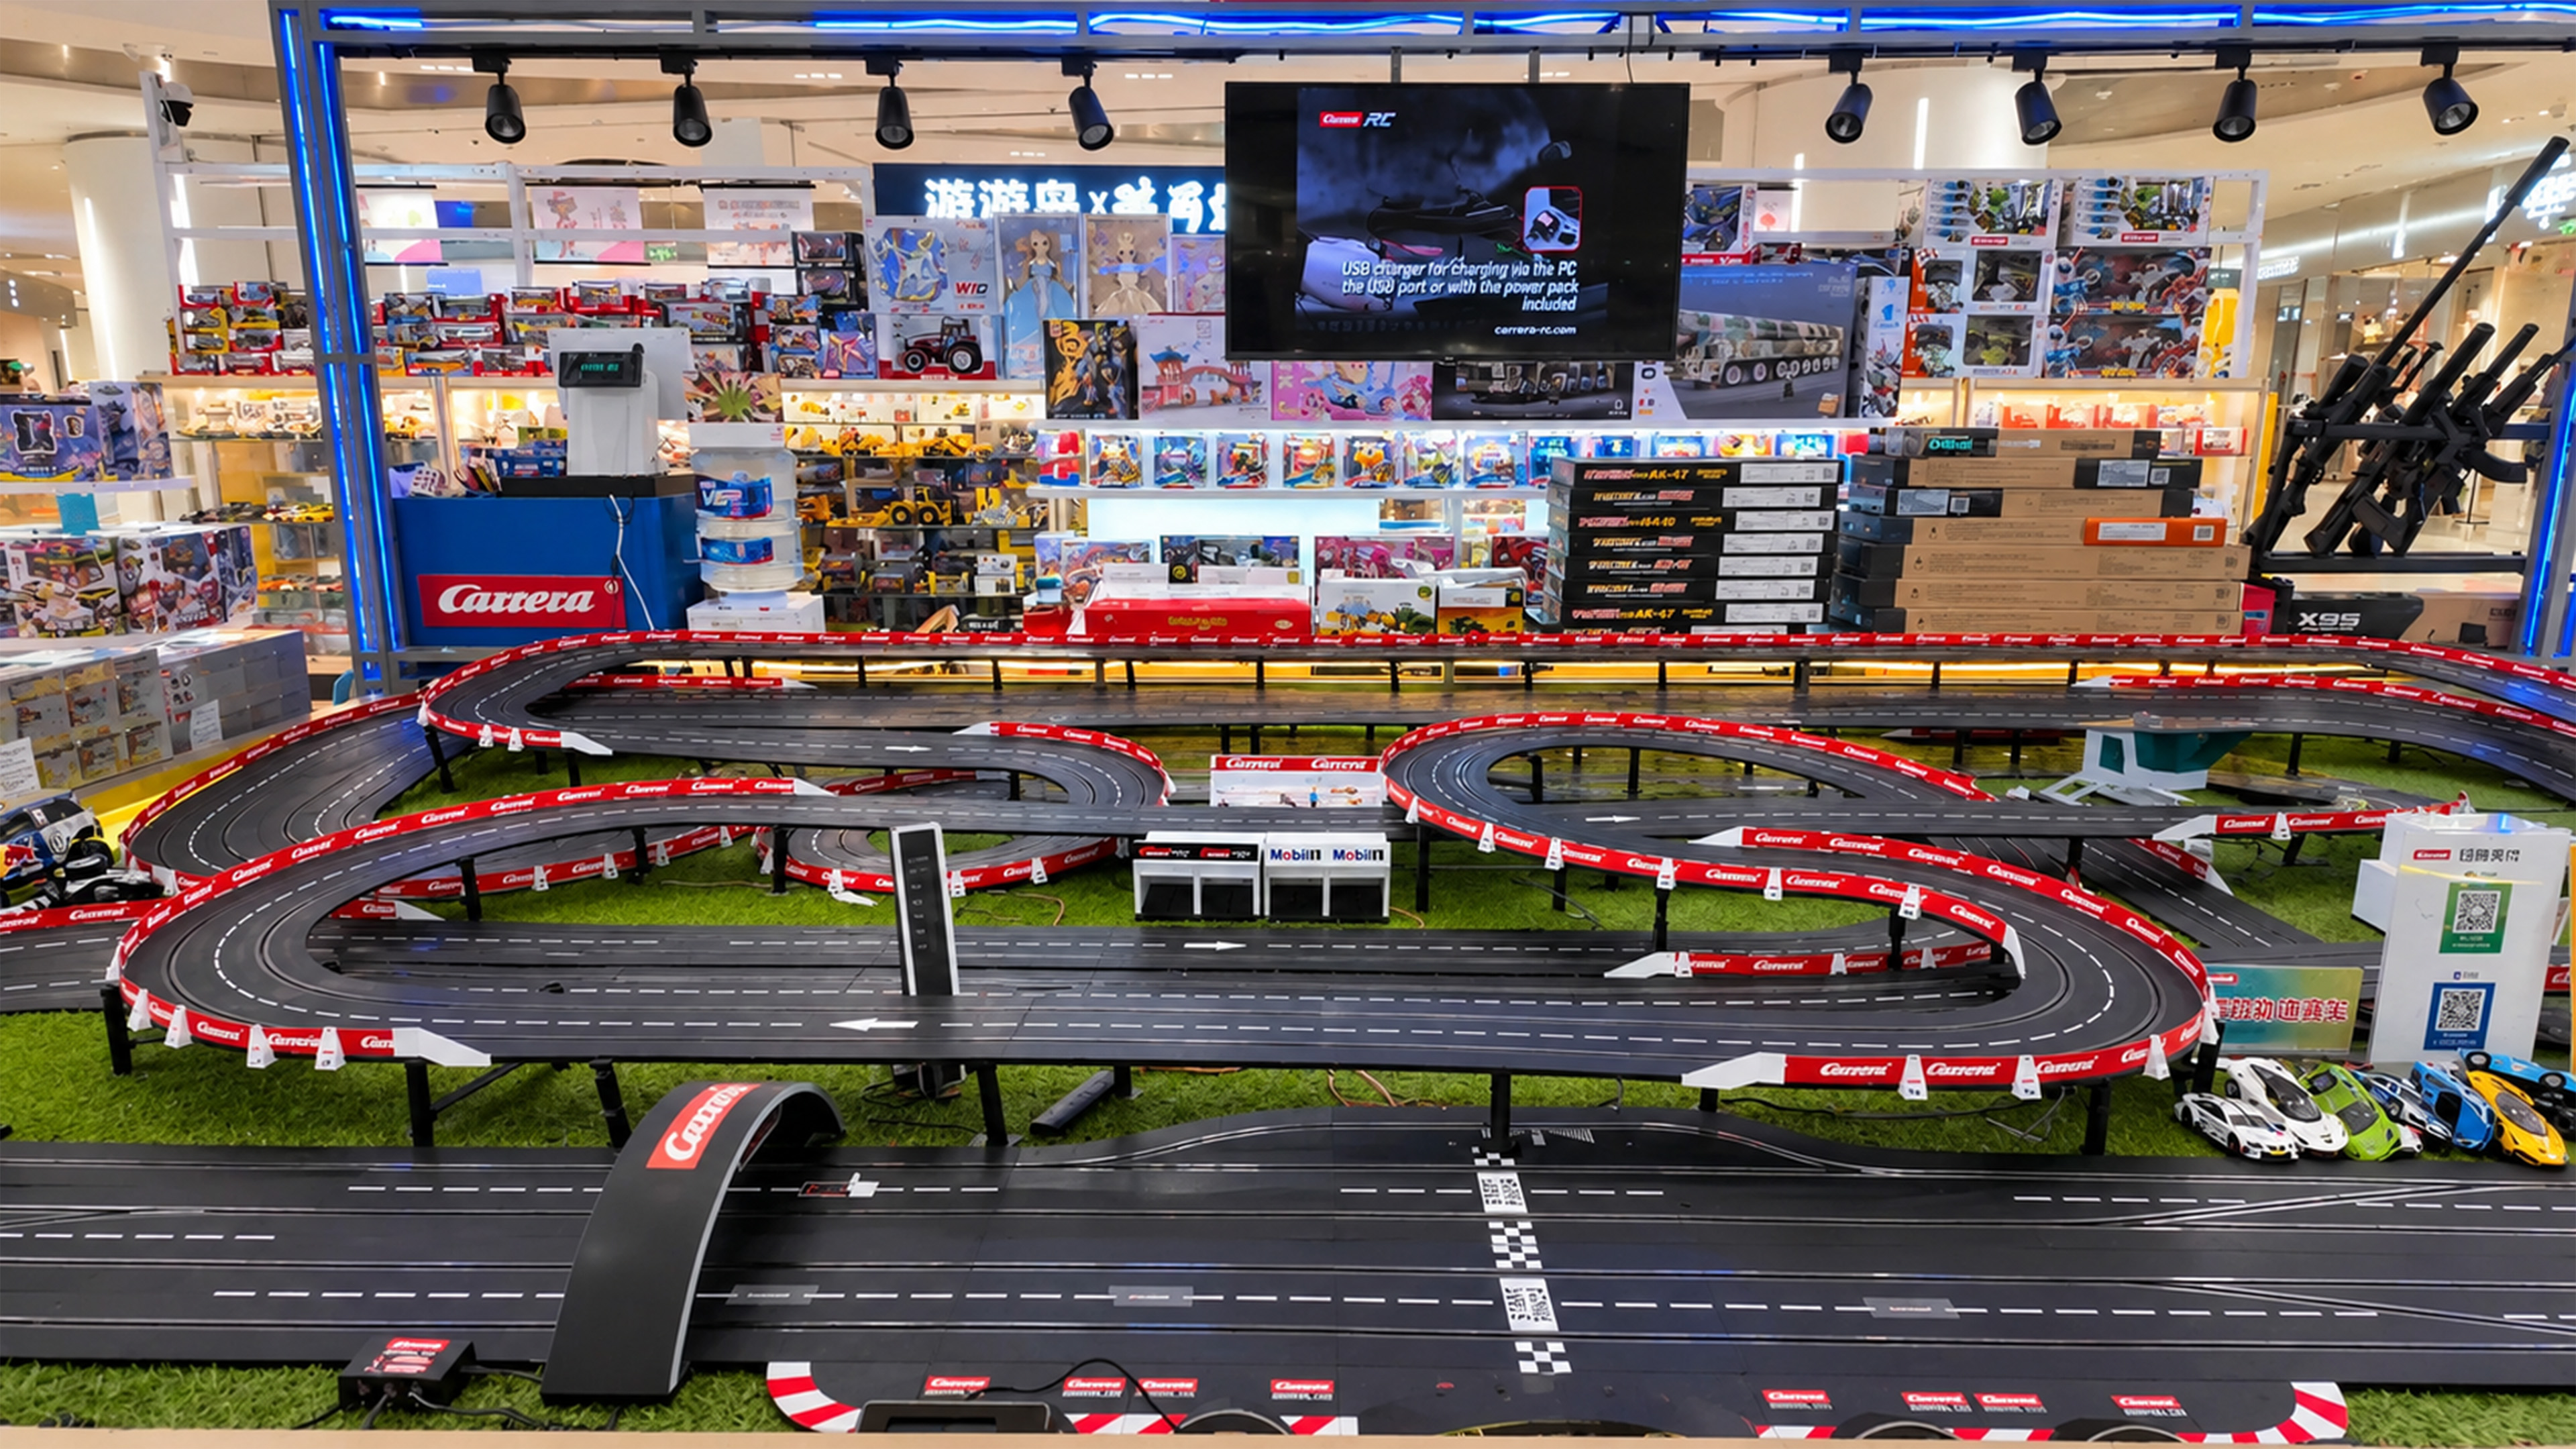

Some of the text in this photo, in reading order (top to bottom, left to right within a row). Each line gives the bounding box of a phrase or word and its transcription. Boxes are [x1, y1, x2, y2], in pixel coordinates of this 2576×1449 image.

[1363, 112, 1397, 127] RC
[1342, 261, 1370, 276] USB
[1428, 261, 1449, 276] for
[1450, 260, 1509, 280] charging
[1534, 260, 1554, 276] the
[1558, 261, 1578, 276] PC
[1342, 279, 1363, 294] the
[1397, 280, 1427, 297] port
[1430, 282, 1446, 294] or
[1448, 279, 1477, 294] with
[1480, 279, 1501, 294] the
[1503, 282, 1545, 298] power
[1547, 278, 1579, 298] pack
[1521, 296, 1577, 311] included
[1495, 325, 1577, 335] carrera-rc.com
[1648, 469, 1690, 480] AK-47
[438, 584, 596, 614] Carrera
[1635, 608, 1676, 619] AK-47
[2298, 612, 2361, 627] X95
[360, 1035, 394, 1049] Carr
[1819, 1062, 1890, 1076] Carrera
[1926, 1062, 1998, 1076] Carrera
